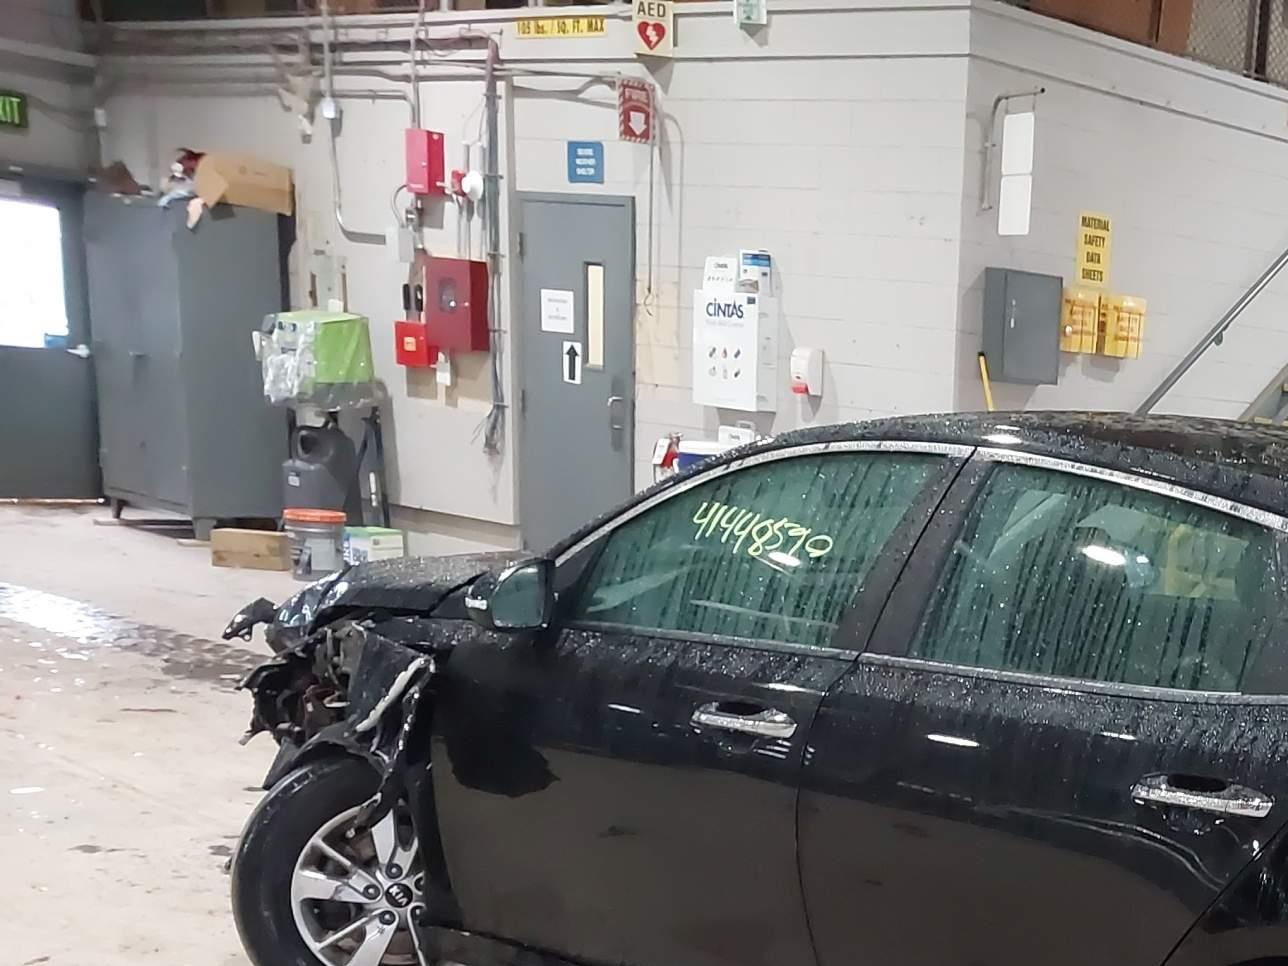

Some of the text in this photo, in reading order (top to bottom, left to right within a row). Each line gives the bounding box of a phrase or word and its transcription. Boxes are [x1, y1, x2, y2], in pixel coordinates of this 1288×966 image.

[637, 2, 666, 17] AED
[557, 19, 569, 34] SQ.
[572, 19, 583, 33] FT.
[586, 17, 604, 32] MAX
[1081, 215, 1110, 232] MATERIAL
[1084, 233, 1105, 248] SAFETY
[1086, 251, 1101, 264] DATA
[1081, 268, 1104, 282] SHEETS
[706, 298, 744, 318] CINTAS
[692, 502, 833, 557] 41448590
[389, 885, 409, 906] KIA
